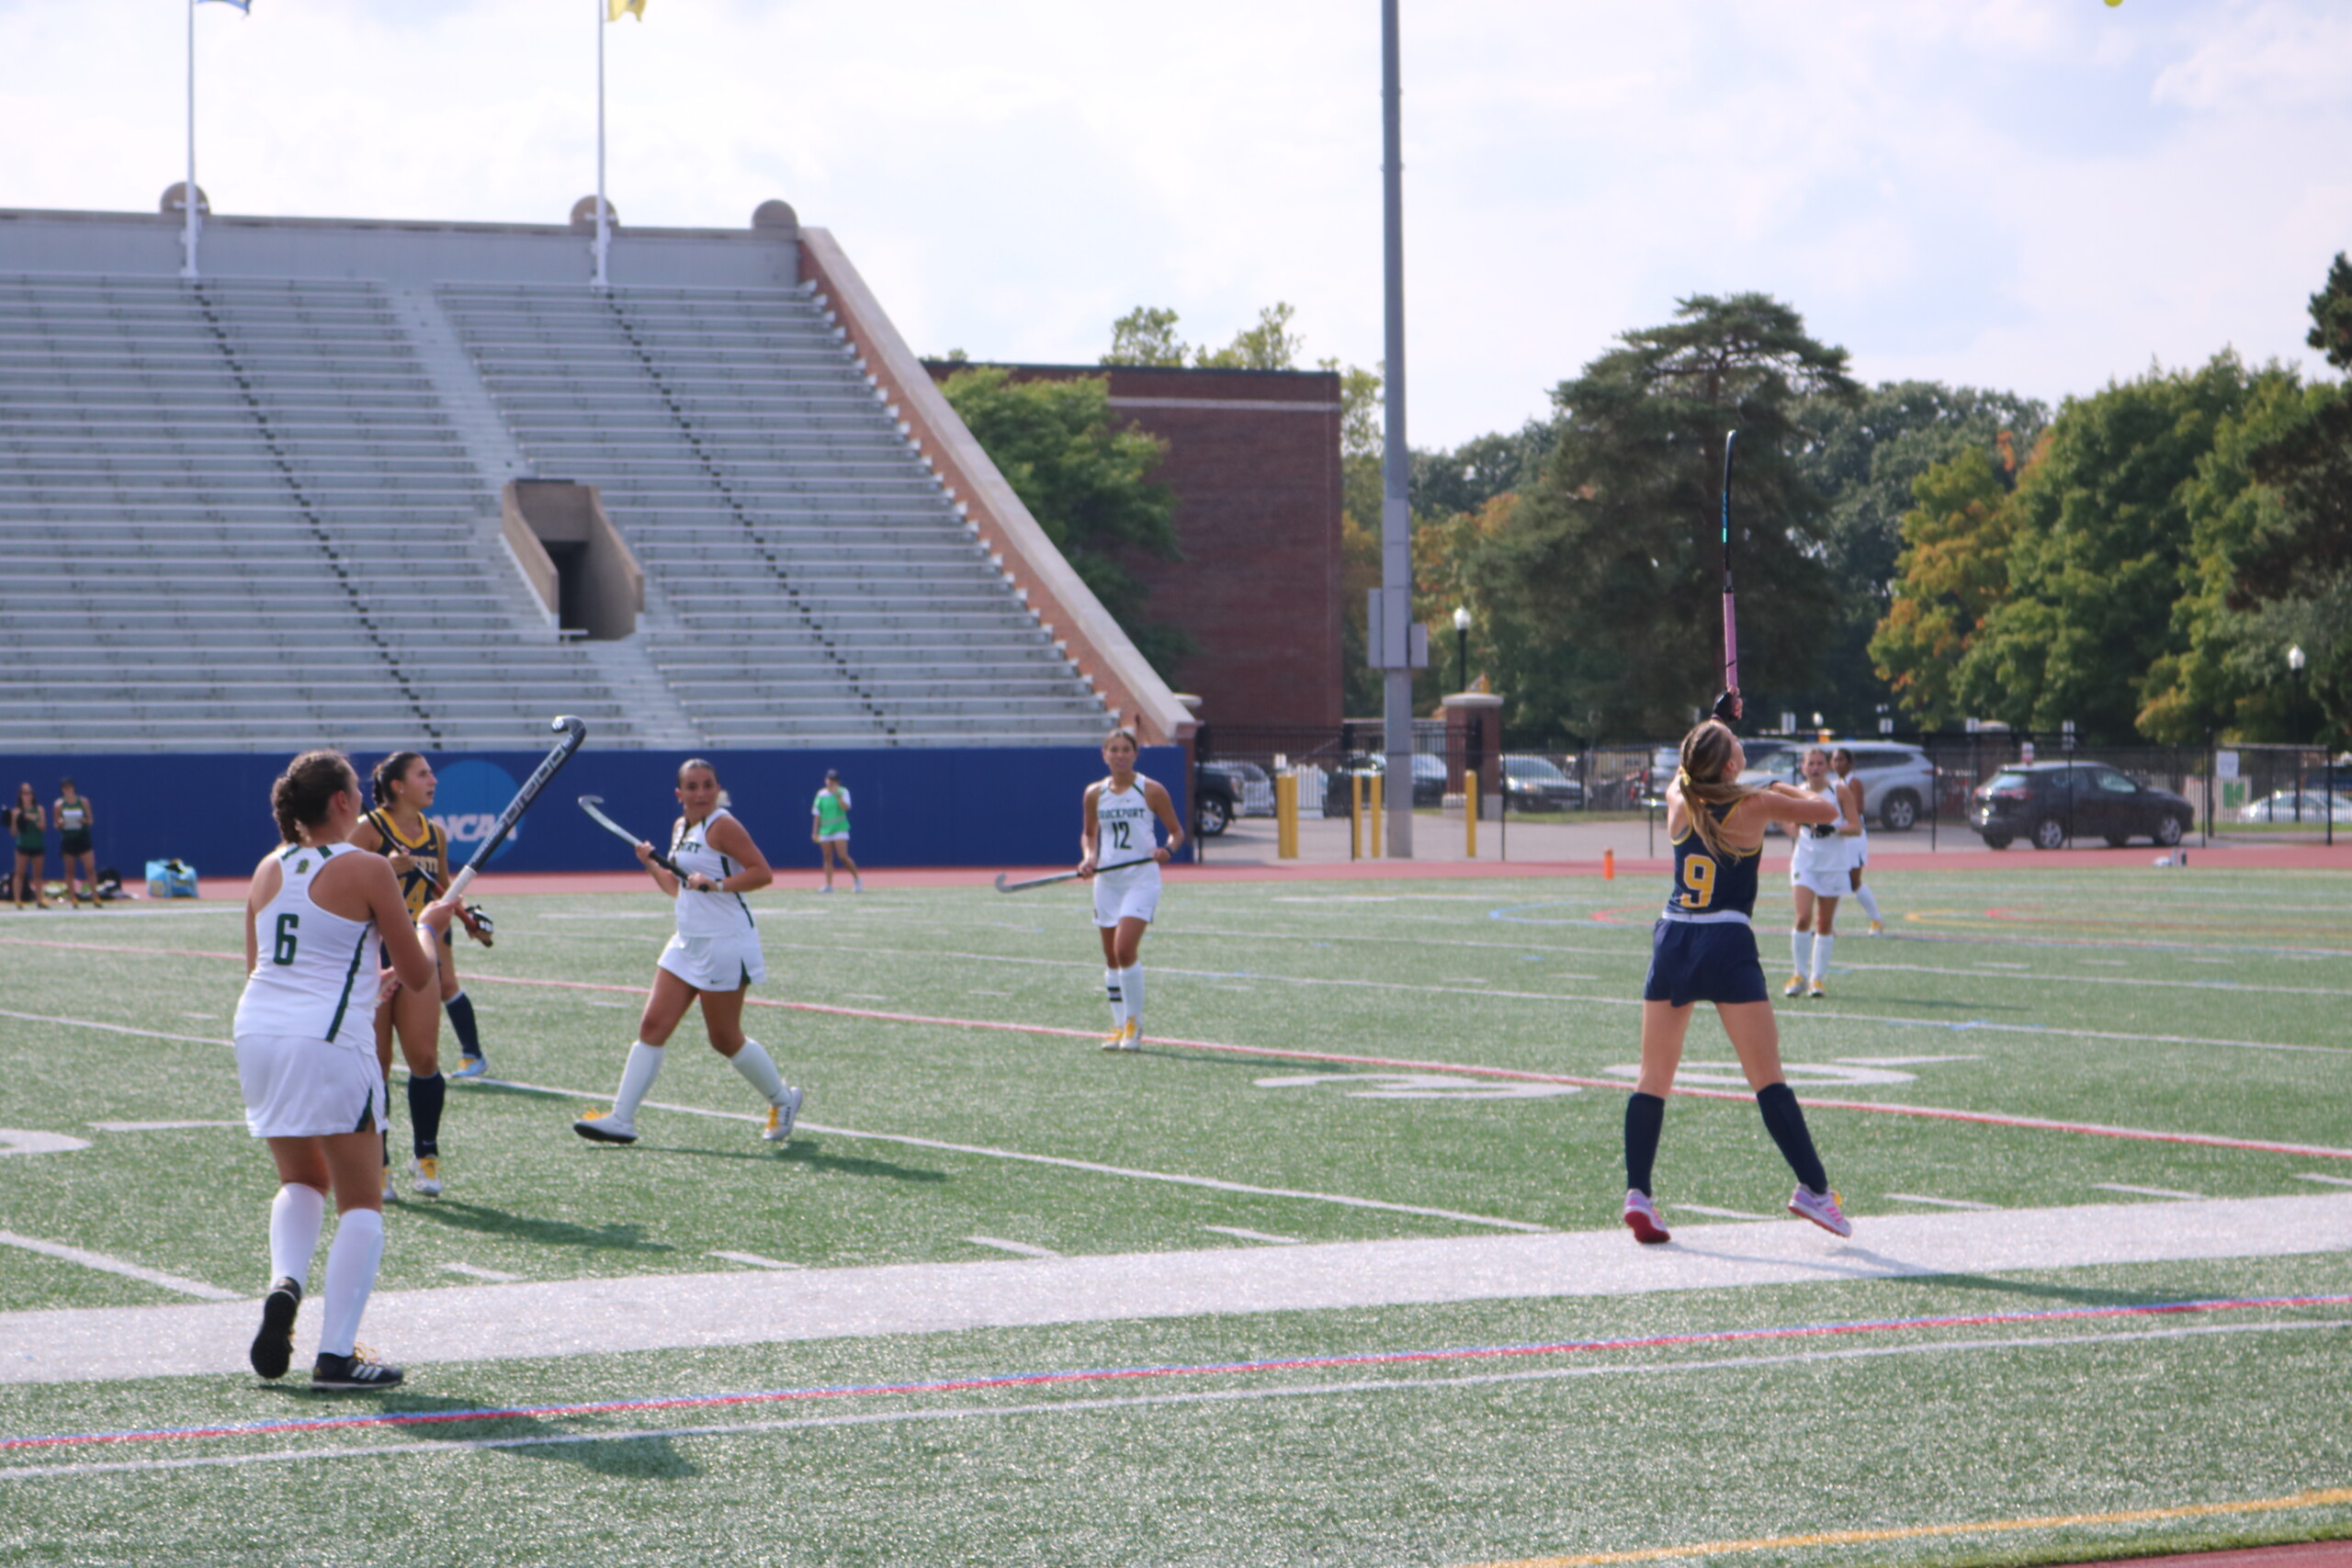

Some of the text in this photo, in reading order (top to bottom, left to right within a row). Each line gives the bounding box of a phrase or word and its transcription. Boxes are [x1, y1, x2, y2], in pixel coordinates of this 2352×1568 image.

[1112, 821, 1132, 850] 12
[1679, 853, 1716, 908] 9
[273, 913, 300, 965] 6
